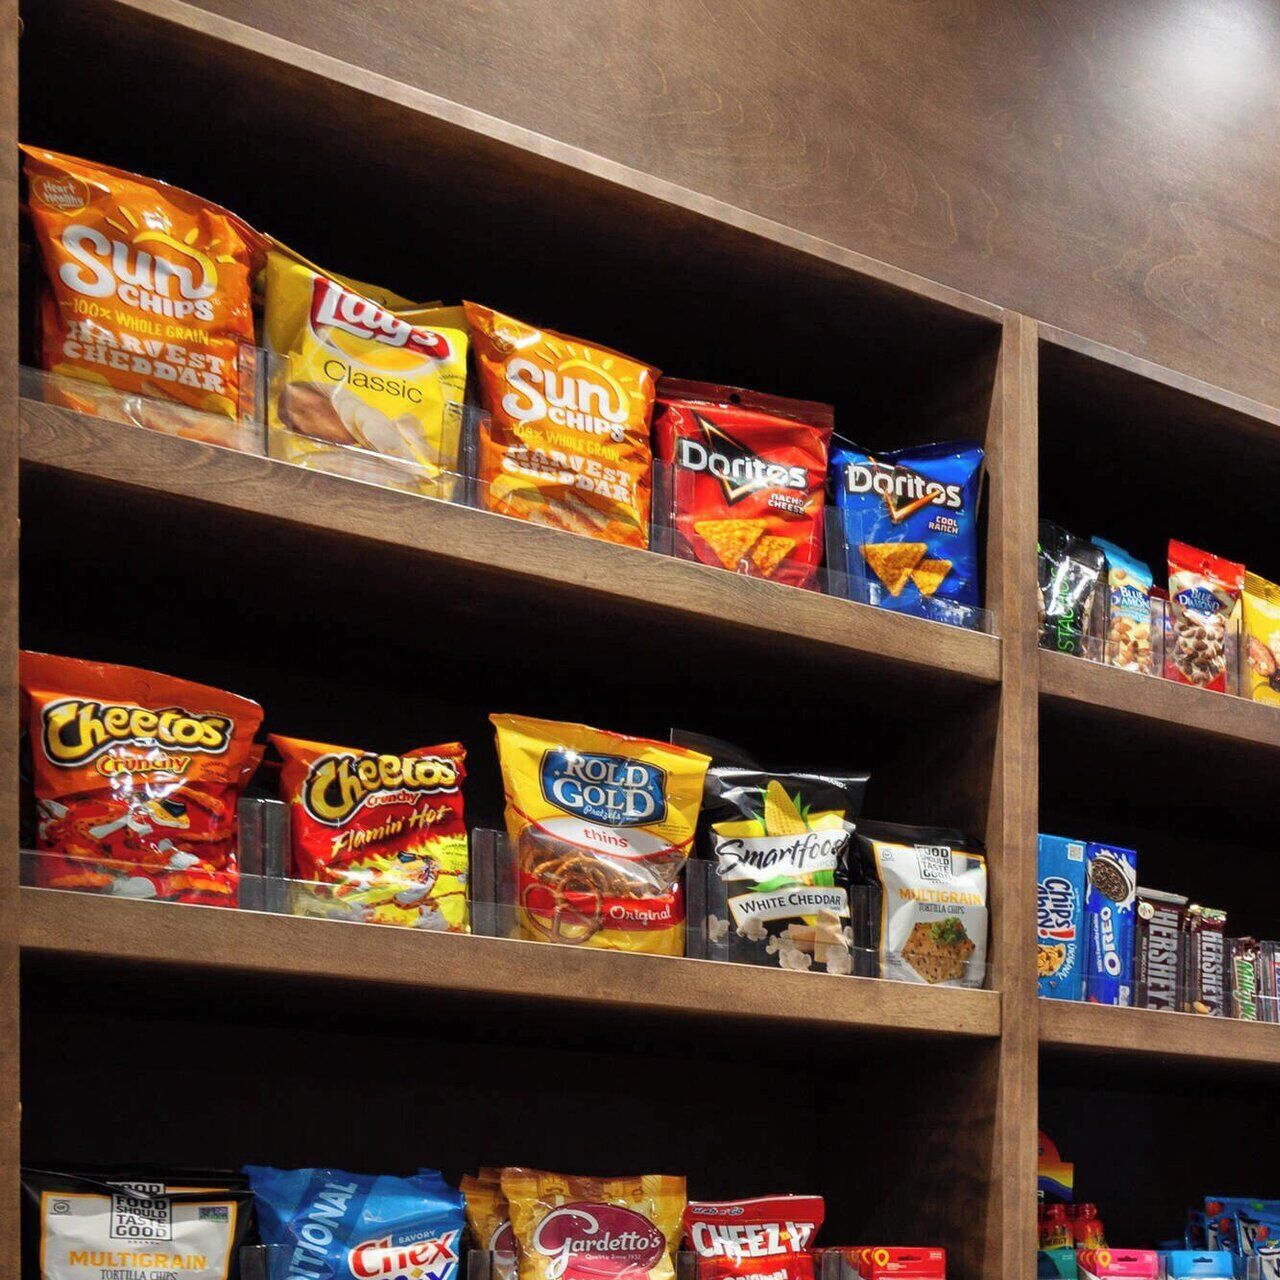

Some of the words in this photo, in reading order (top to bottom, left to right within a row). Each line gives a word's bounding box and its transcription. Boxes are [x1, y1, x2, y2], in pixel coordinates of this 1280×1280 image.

[59, 224, 217, 299] Sun
[117, 282, 215, 321] CHIPS
[72, 298, 112, 322] 100%
[116, 313, 162, 338] WHOLE
[166, 324, 209, 345] GRAIN
[66, 321, 225, 374] HARVEST
[62, 341, 226, 394] CHEDDAR
[323, 359, 423, 404] Classic
[502, 358, 630, 424] Sun
[552, 411, 628, 442] CHIPS
[545, 431, 583, 453] WHOLE
[585, 441, 620, 462] GRAIN
[508, 444, 631, 488] HARVEST
[681, 439, 807, 488] Doritos
[502, 457, 631, 503] CHEDDAR
[847, 463, 962, 510] Doritos
[770, 493, 804, 508] NACHO
[927, 522, 960, 535] RANCH
[935, 515, 958, 526] COOL
[45, 702, 231, 762] Cheetos
[96, 753, 192, 778] Crunchy
[563, 754, 648, 787] ROLD
[306, 754, 459, 823] Cheetos
[364, 790, 420, 809] Crunchy
[551, 776, 655, 815] GOLD
[405, 804, 454, 830] Hot
[583, 828, 629, 849] thins
[715, 830, 850, 873] Smartfood
[609, 902, 671, 924] Original
[739, 894, 786, 914] WHITE
[788, 892, 842, 910] CHEDDAR
[898, 888, 982, 906] MULTIGRAIN
[918, 902, 946, 914] TORTILLA
[947, 905, 965, 915] CHIPS
[1101, 907, 1121, 976] OREO
[116, 1206, 168, 1219] SHOULD
[117, 1196, 166, 1211] FOOD
[116, 1225, 168, 1239] GOOD
[117, 1214, 167, 1228] TASTE
[397, 1230, 436, 1244] SAVORY
[350, 1230, 459, 1278] Chex
[533, 1208, 661, 1280] Gardetto's
[69, 1250, 207, 1271] MULTIGRAIN
